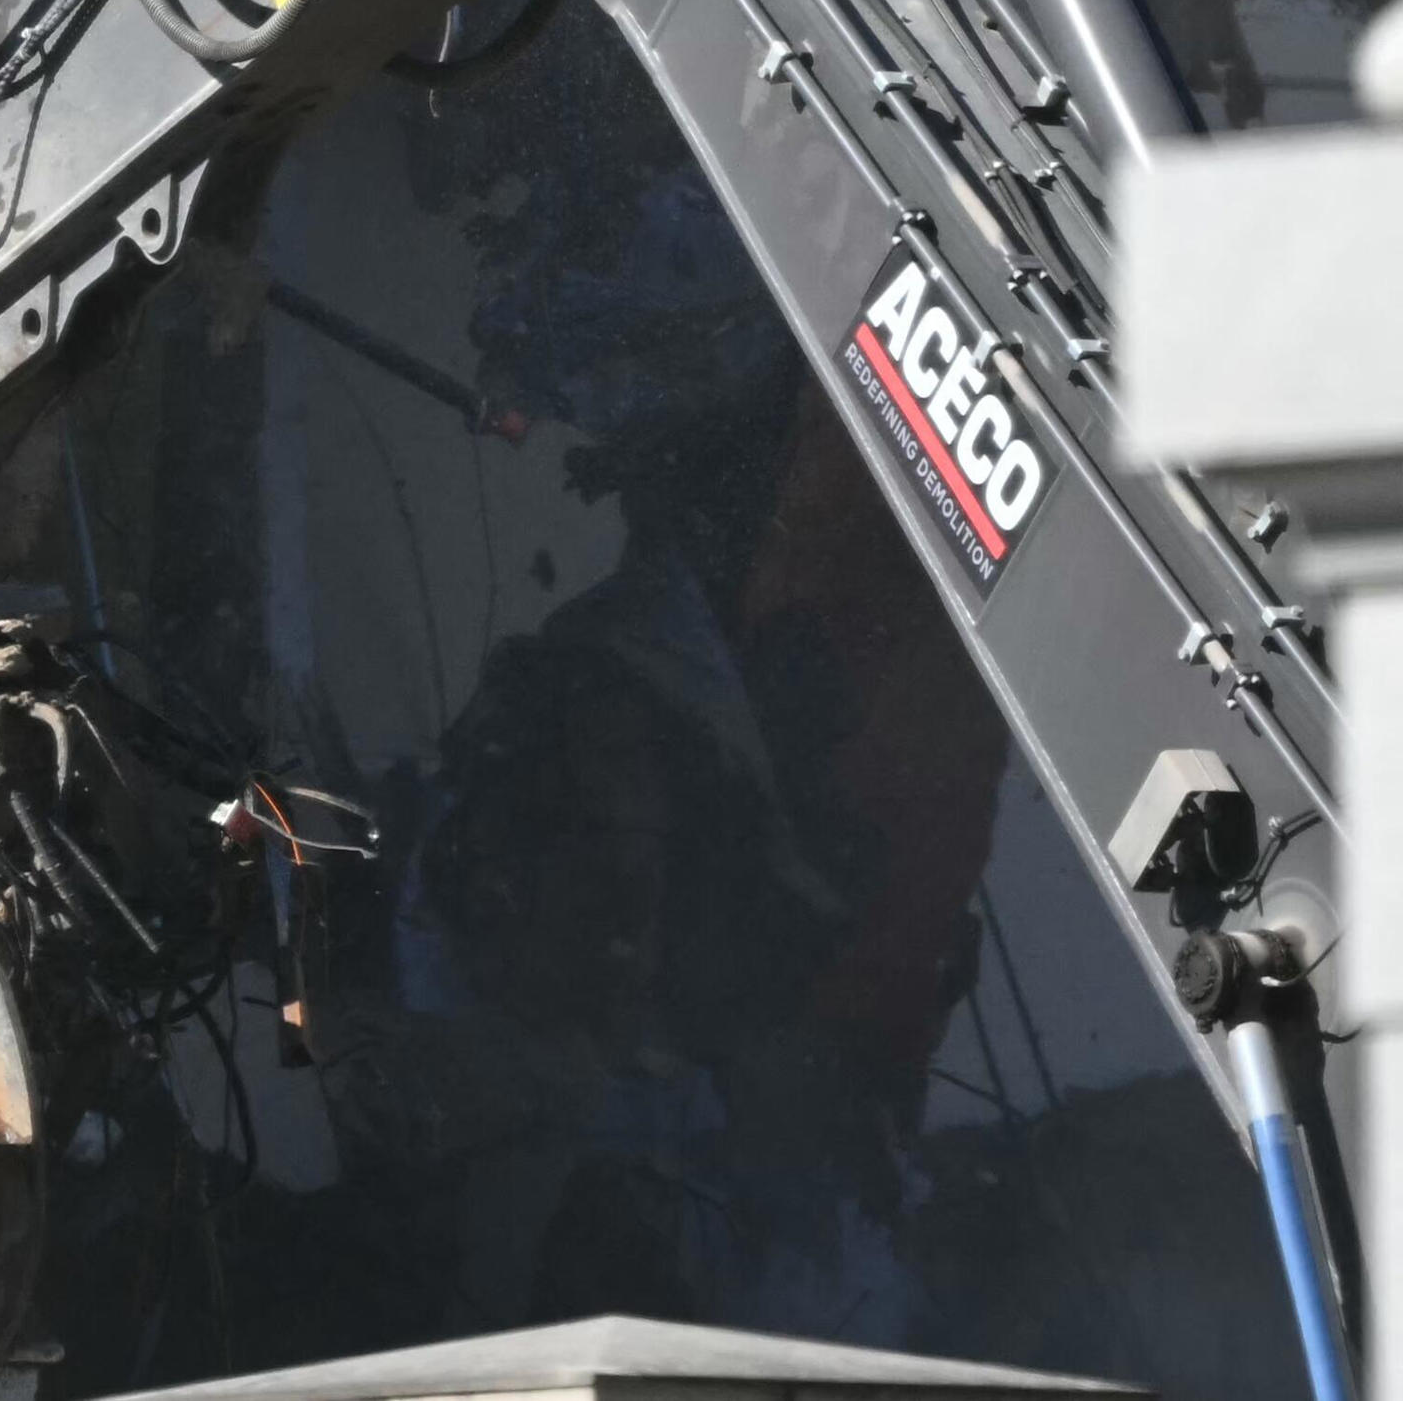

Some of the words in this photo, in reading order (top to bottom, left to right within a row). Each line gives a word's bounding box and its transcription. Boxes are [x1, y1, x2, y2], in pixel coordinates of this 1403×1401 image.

[845, 343, 918, 461] REDEFINING
[915, 456, 995, 582] DEMOLITION
[866, 260, 1041, 531] ACECO
